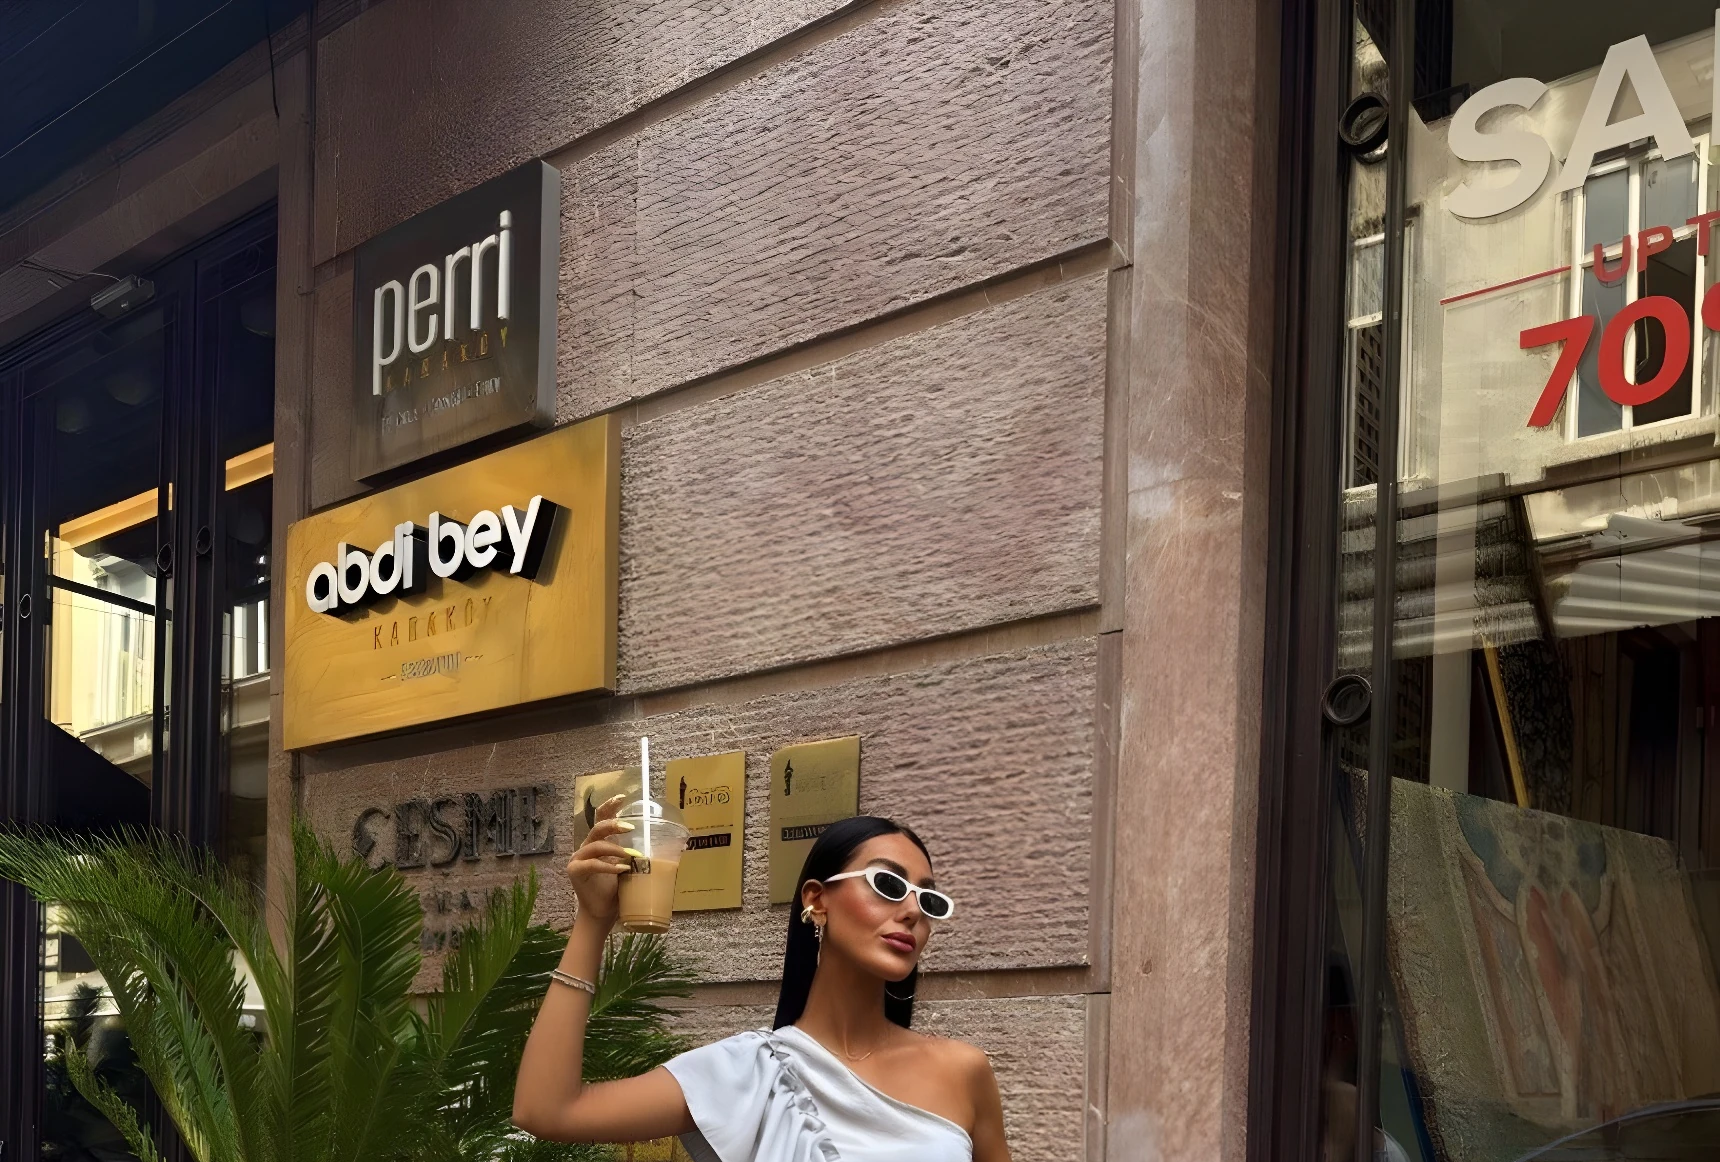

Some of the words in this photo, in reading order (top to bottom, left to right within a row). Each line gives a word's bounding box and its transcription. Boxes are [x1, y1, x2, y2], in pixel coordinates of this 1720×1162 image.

[1446, 8, 1720, 220] SA
[372, 210, 513, 396] perri
[1592, 225, 1673, 284] UP
[306, 520, 414, 614] abdi
[428, 495, 544, 579] bey
